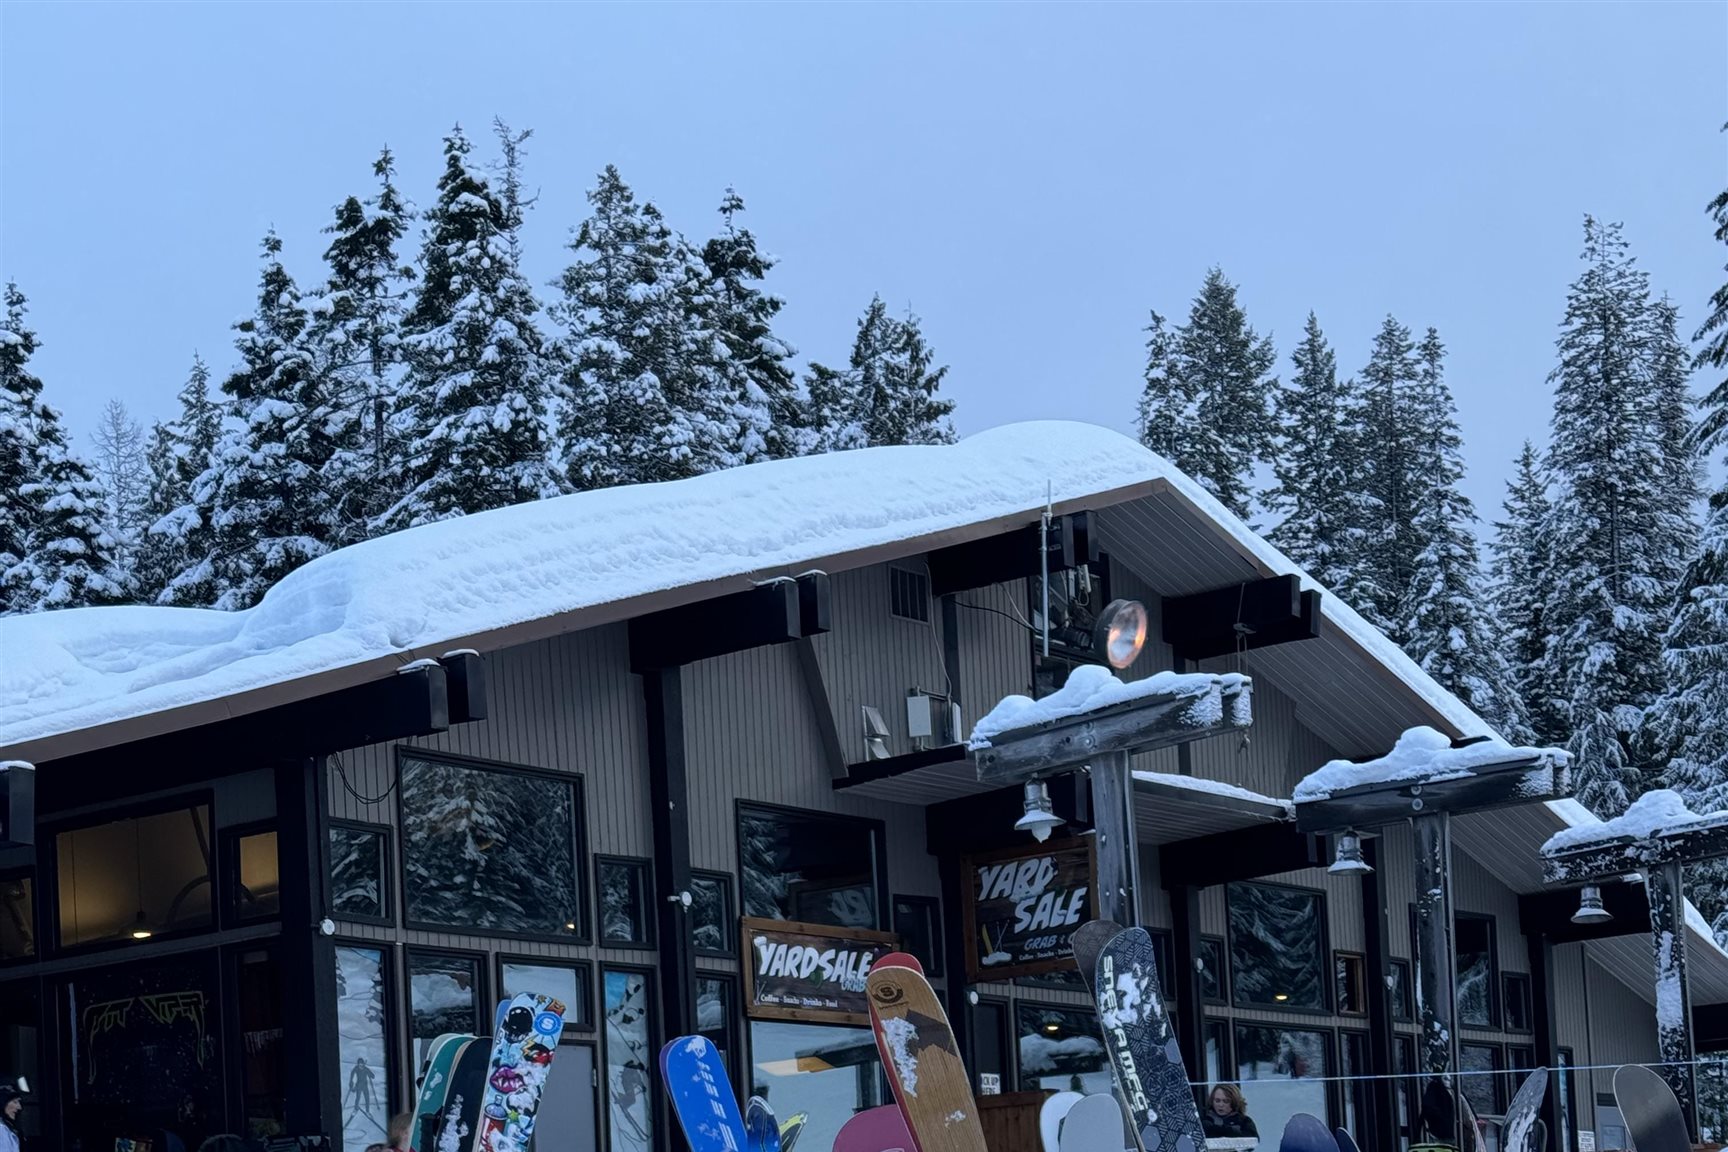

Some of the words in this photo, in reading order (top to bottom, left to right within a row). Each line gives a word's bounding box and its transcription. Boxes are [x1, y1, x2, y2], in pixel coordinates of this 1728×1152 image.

[978, 857, 1057, 902] YARD
[1014, 887, 1088, 934] SALE
[1024, 935, 1057, 951] GRAB
[840, 979, 866, 993] GRAB
